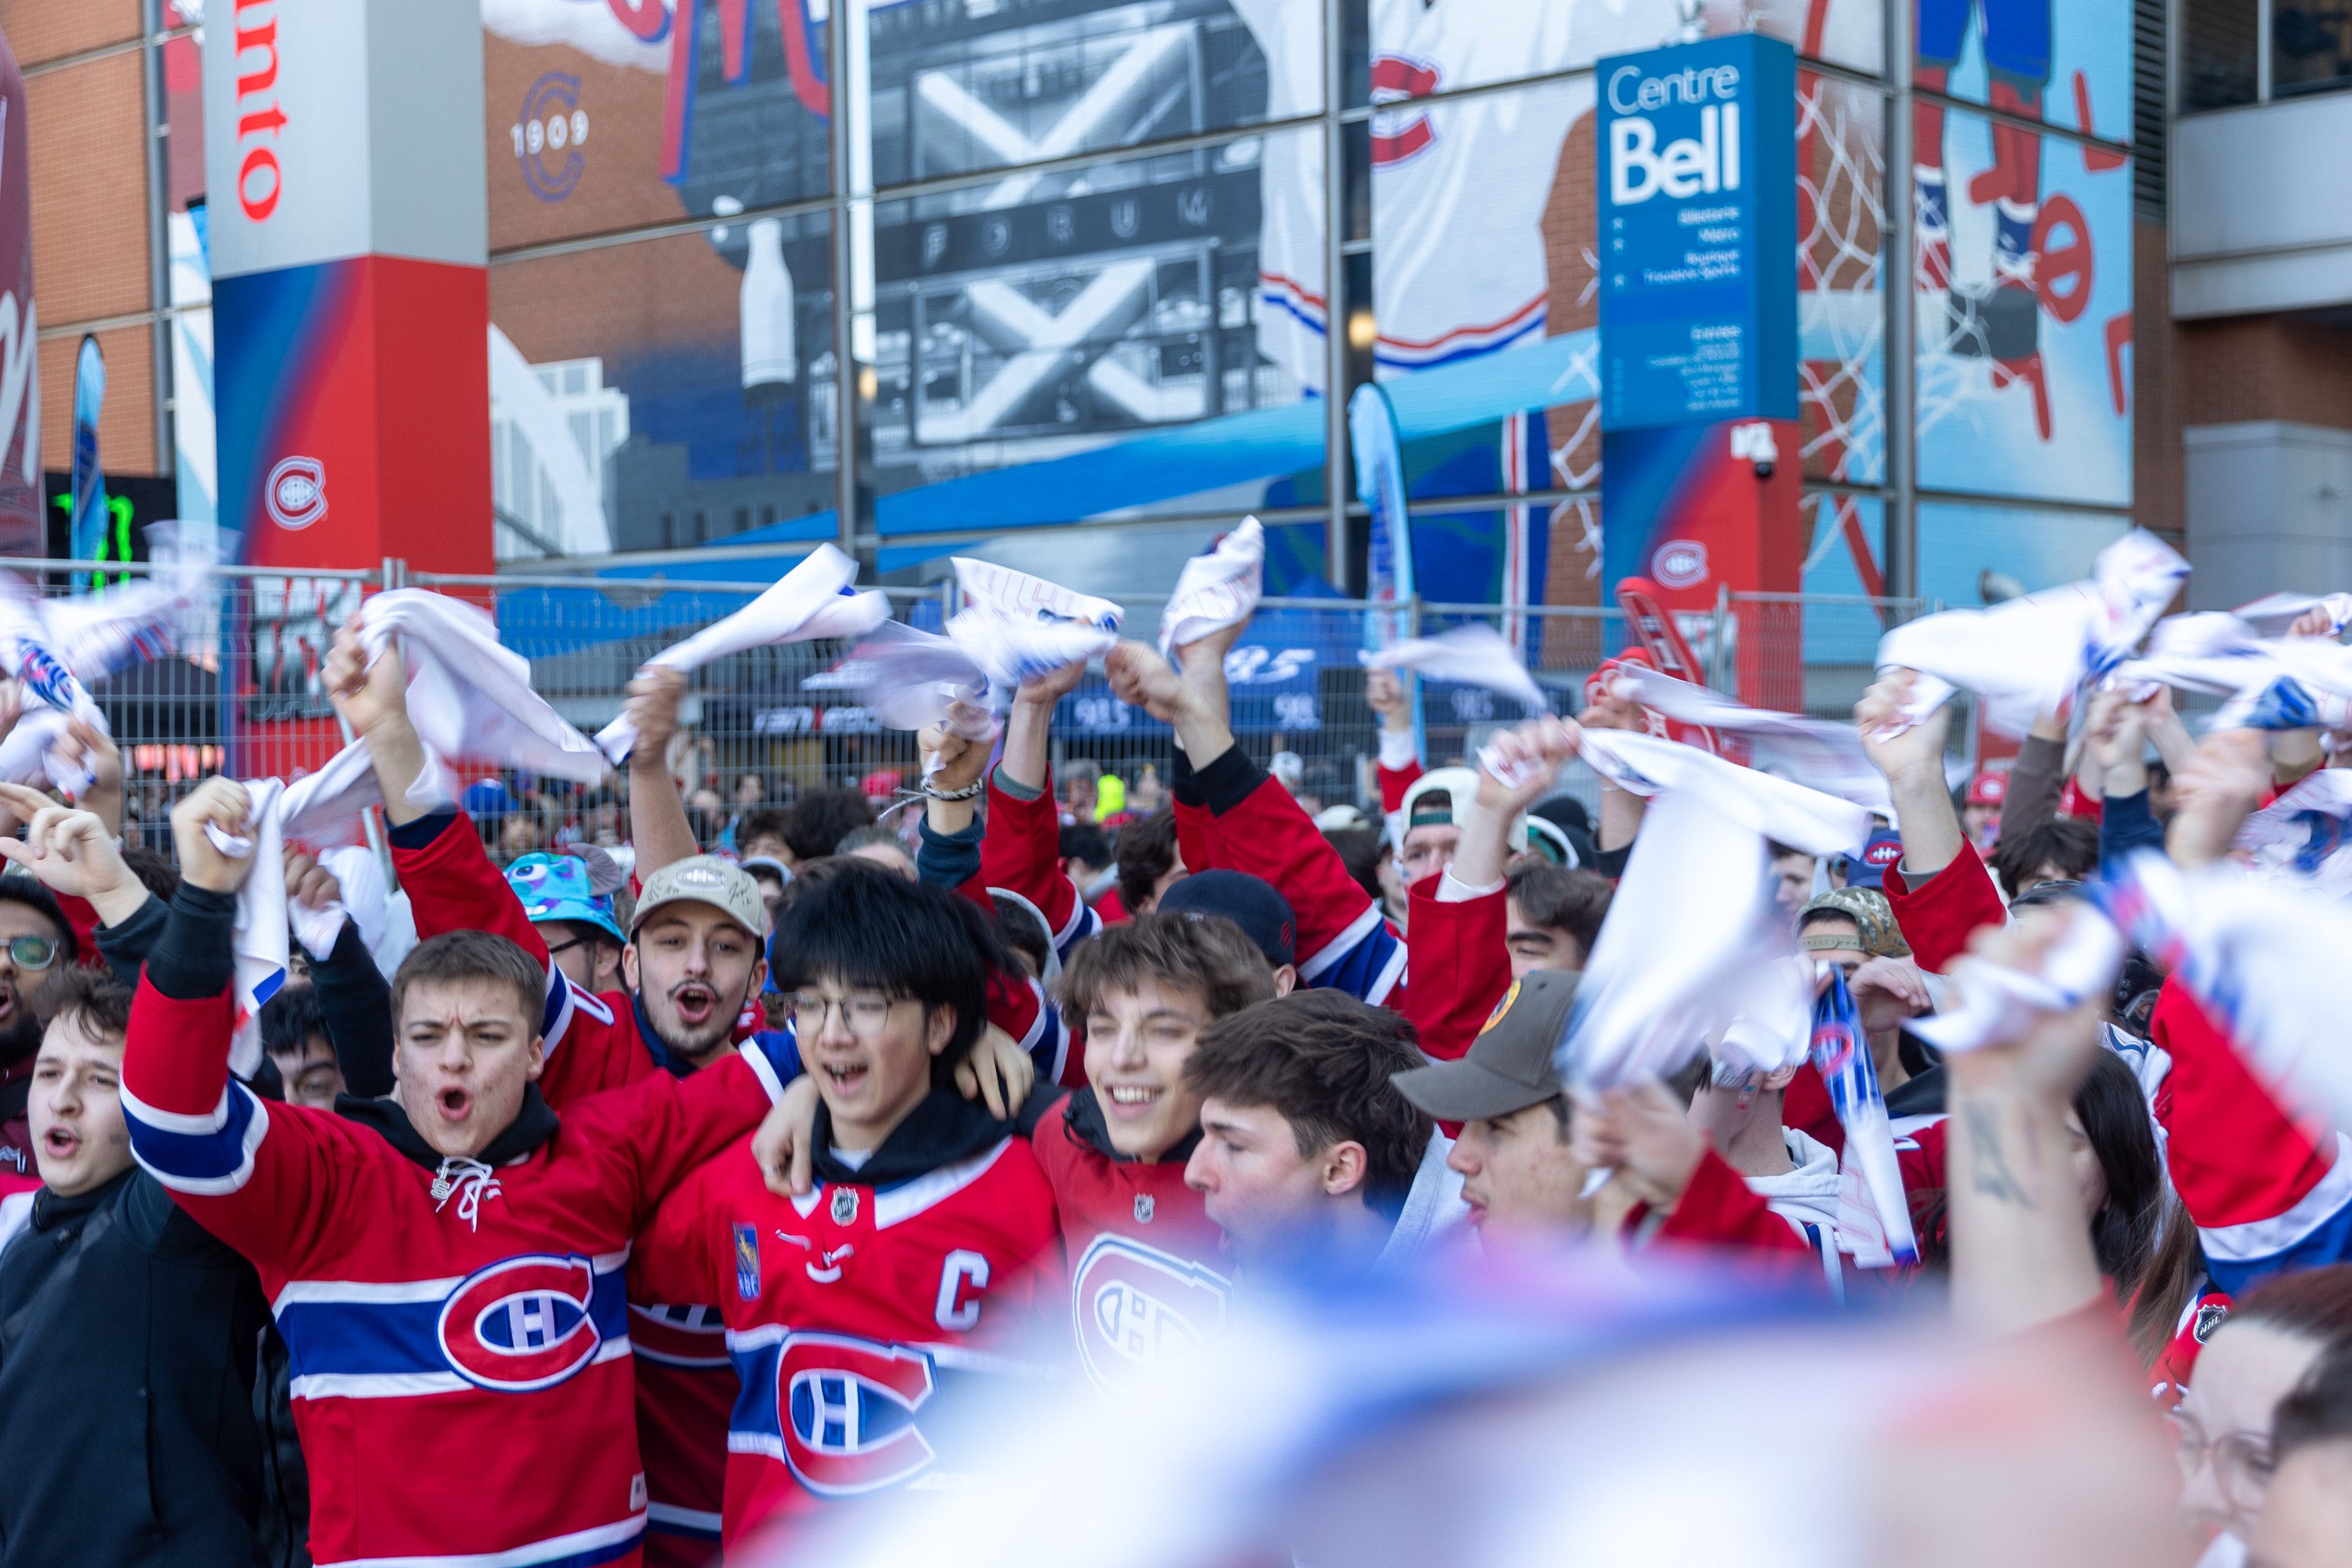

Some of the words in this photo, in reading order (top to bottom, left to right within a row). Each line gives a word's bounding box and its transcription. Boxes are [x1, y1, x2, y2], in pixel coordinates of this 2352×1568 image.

[1608, 64, 1740, 115] Centre
[510, 109, 589, 158] 1909
[1610, 100, 1741, 206] Bell
[935, 1248, 990, 1331] C
[2200, 1316, 2220, 1336] NHL
